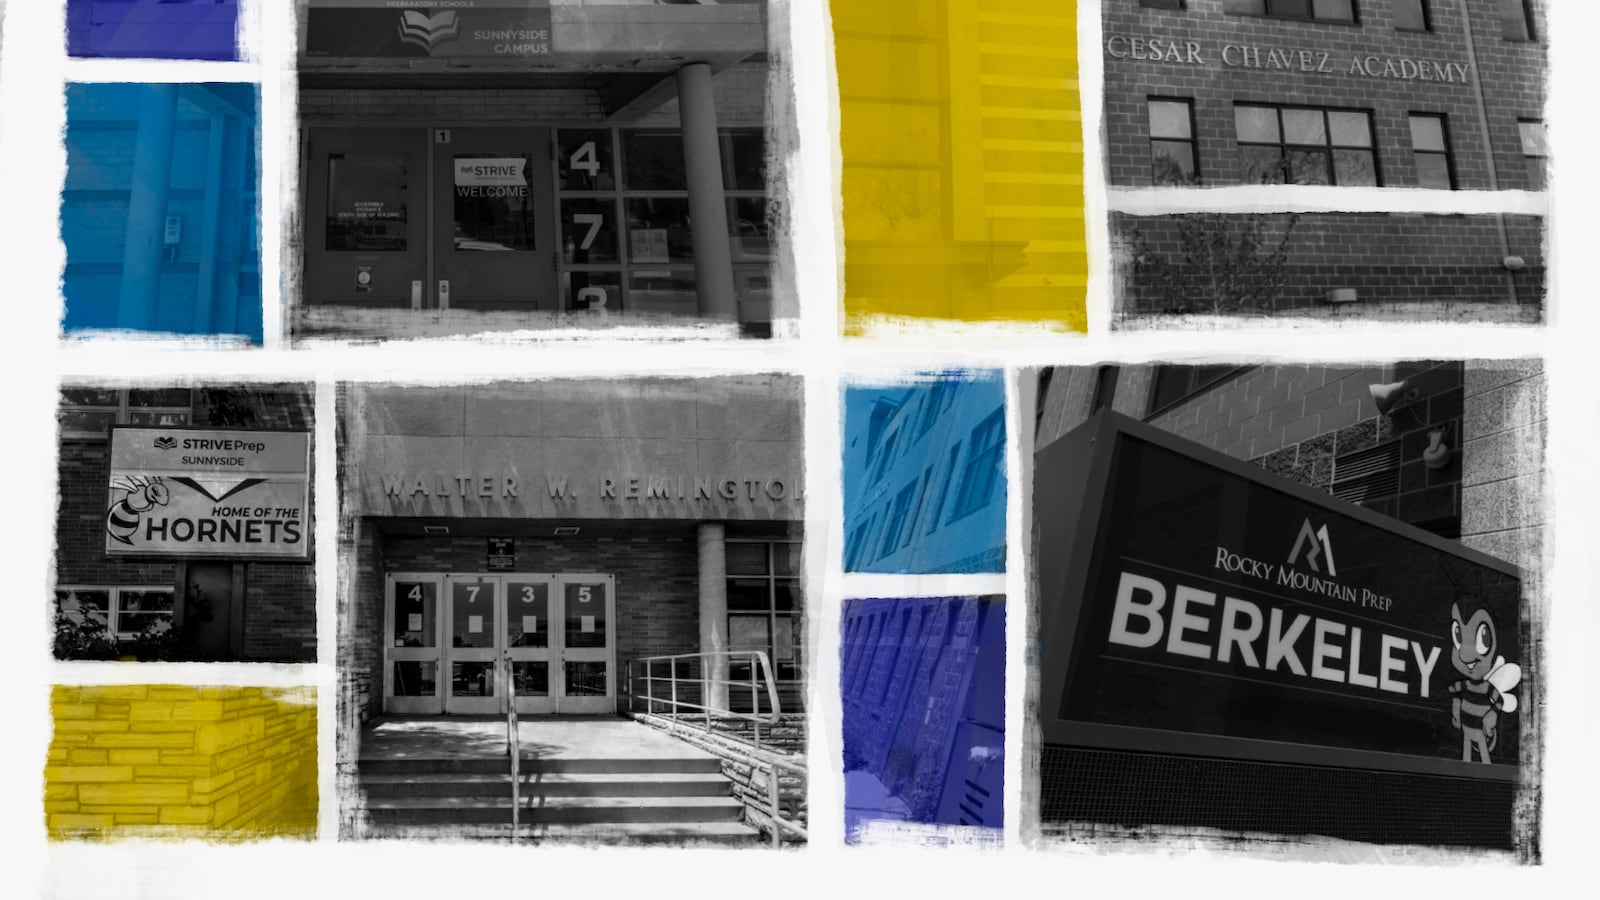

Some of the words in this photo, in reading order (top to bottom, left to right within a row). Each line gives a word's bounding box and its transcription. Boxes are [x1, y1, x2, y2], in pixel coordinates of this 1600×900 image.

[474, 30, 548, 41] SUNNYSIDE
[494, 43, 548, 54] CAMPUS
[1107, 35, 1204, 64] CESAR
[1222, 44, 1333, 73] CHAVEZ
[1349, 55, 1470, 83] ACADEMY
[439, 132, 446, 142] 1
[570, 141, 600, 177] 4
[475, 166, 517, 176] STRIVE
[457, 186, 528, 198] WELCOME
[573, 213, 604, 250] 7
[577, 287, 608, 316] 3
[181, 455, 245, 466] SUNNYSIDE
[382, 474, 519, 499] WALTER
[547, 475, 577, 499] W.
[212, 507, 250, 518] HOME
[254, 507, 272, 518] OF
[275, 508, 299, 518] THE
[146, 517, 301, 544] HORNETS
[1214, 546, 1274, 580] ROCKY
[1277, 564, 1357, 604] MOUNTAIN
[1361, 588, 1393, 612] PREP
[407, 585, 422, 602] 4
[466, 586, 480, 603] 7
[521, 586, 535, 603] 3
[578, 586, 592, 603] 5
[1108, 571, 1442, 698] BERKELEY
